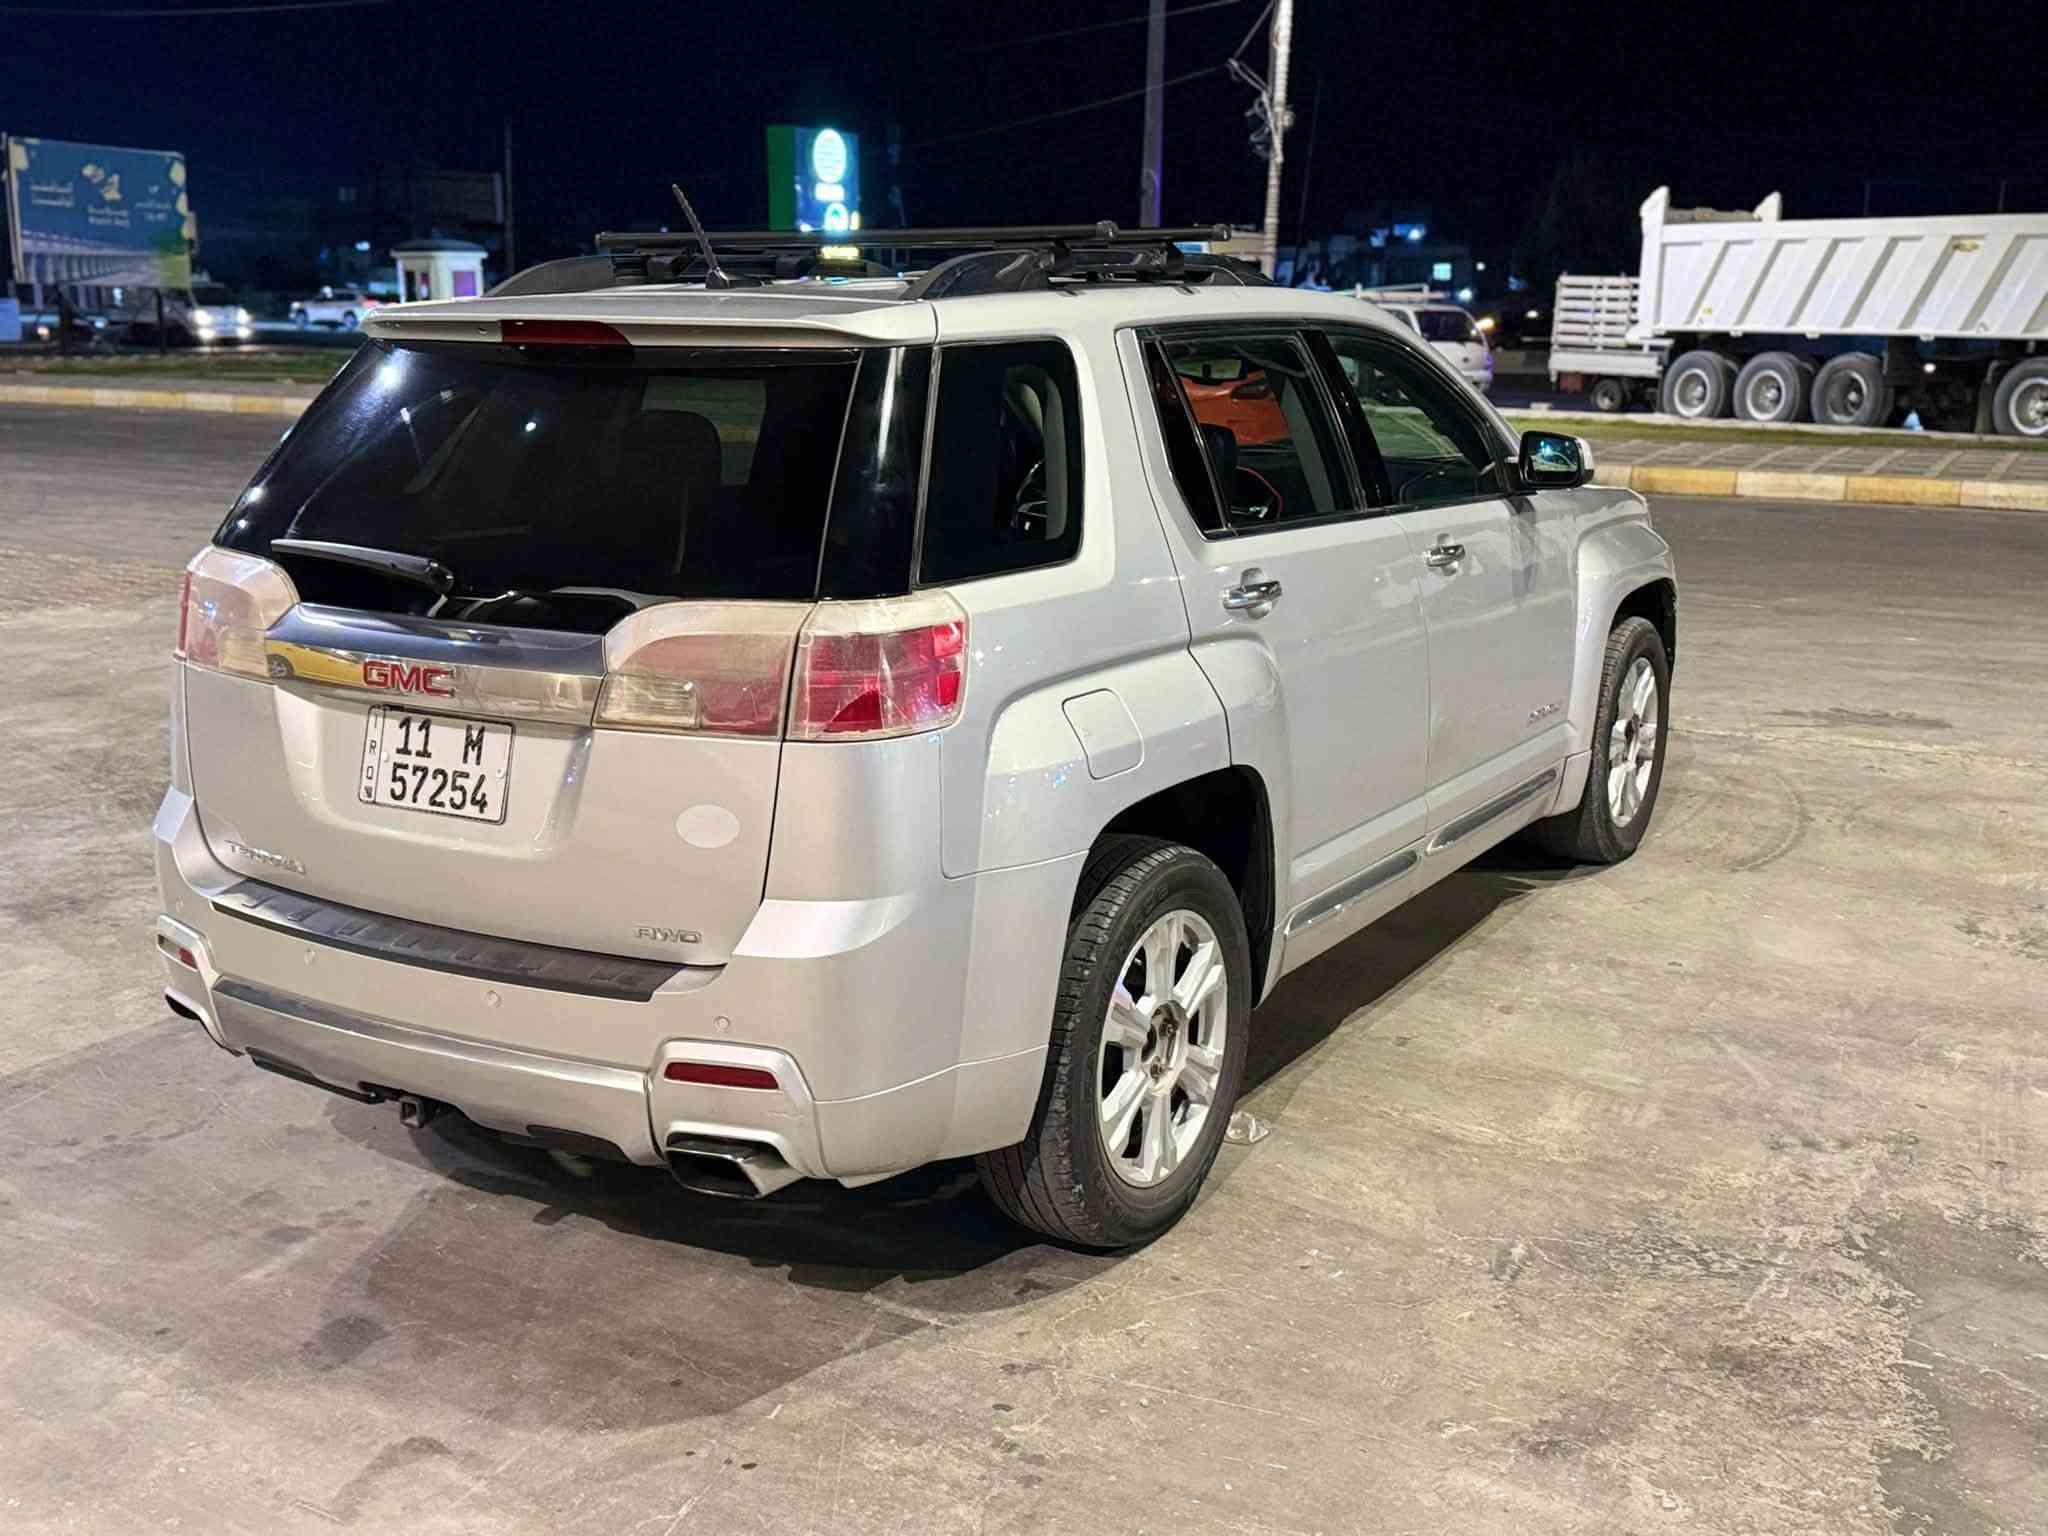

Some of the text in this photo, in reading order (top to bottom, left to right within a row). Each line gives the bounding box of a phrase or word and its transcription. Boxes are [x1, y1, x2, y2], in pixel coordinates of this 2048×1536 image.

[363, 660, 456, 698] GMC
[396, 715, 486, 766] 11 M
[390, 761, 489, 814] 57254
